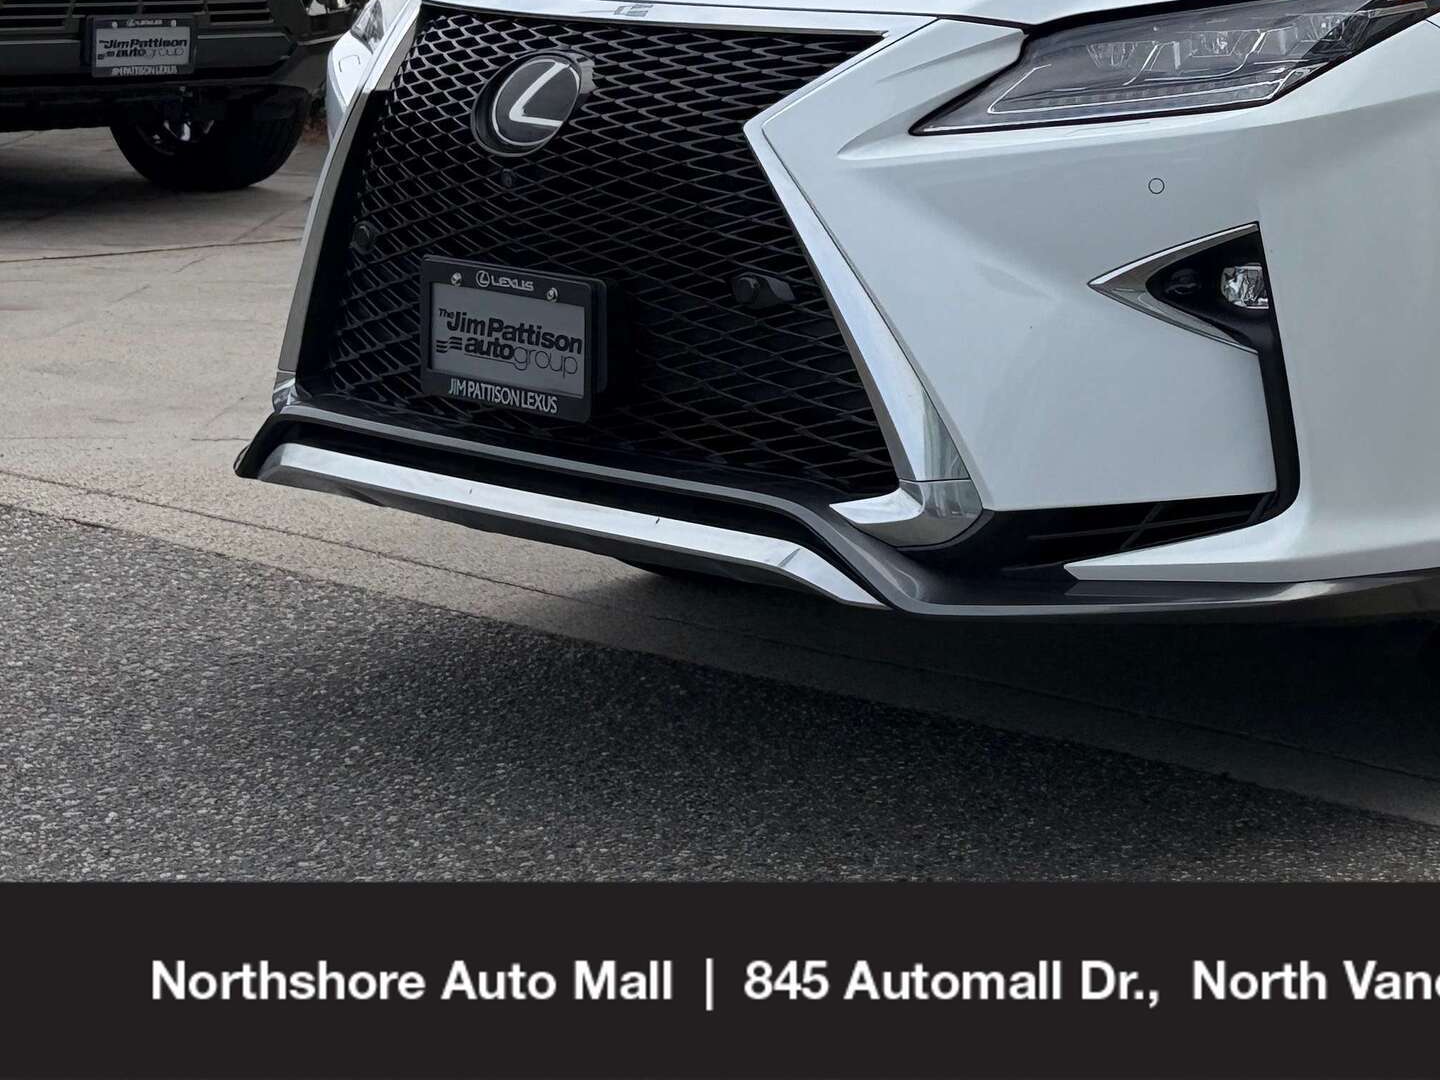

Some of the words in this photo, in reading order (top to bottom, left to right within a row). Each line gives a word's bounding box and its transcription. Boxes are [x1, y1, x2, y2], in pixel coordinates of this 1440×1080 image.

[491, 274, 534, 291] LEXUS
[448, 377, 466, 396] JIM
[467, 383, 520, 407] PATTISON
[521, 391, 558, 414] LEXUS
